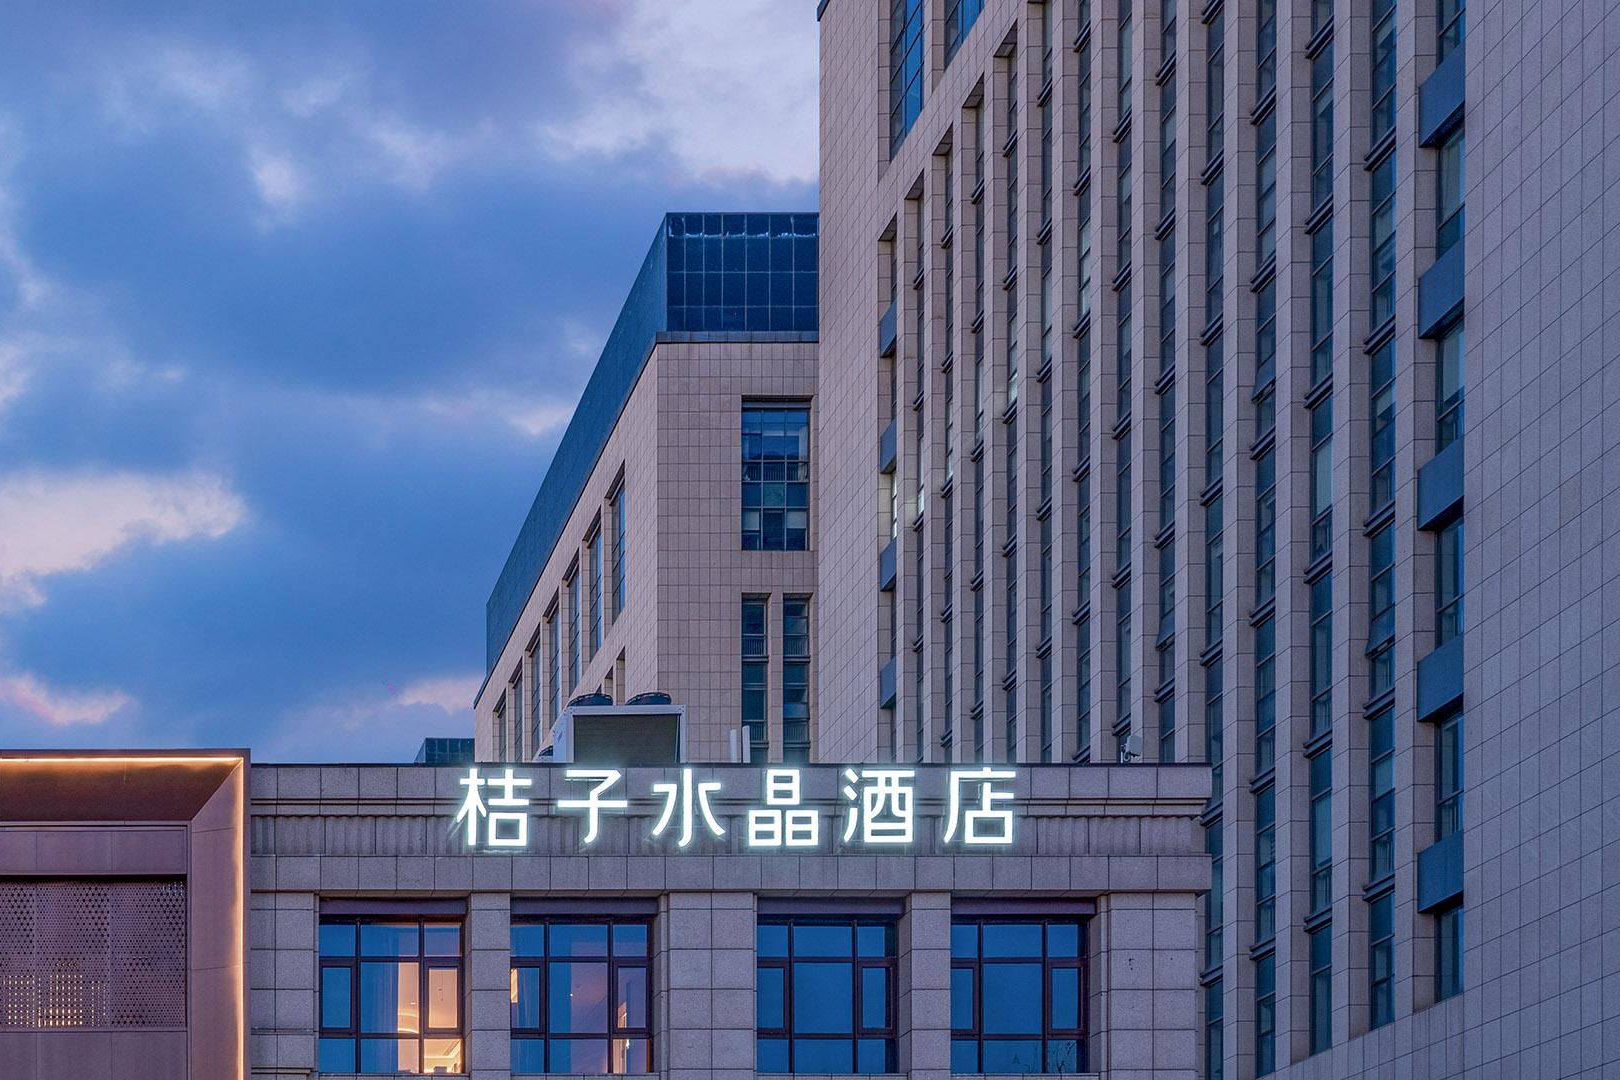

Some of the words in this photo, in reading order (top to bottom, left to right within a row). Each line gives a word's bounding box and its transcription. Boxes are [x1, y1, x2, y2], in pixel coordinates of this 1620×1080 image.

[456, 767, 1017, 848] 桔子水晶酒店
